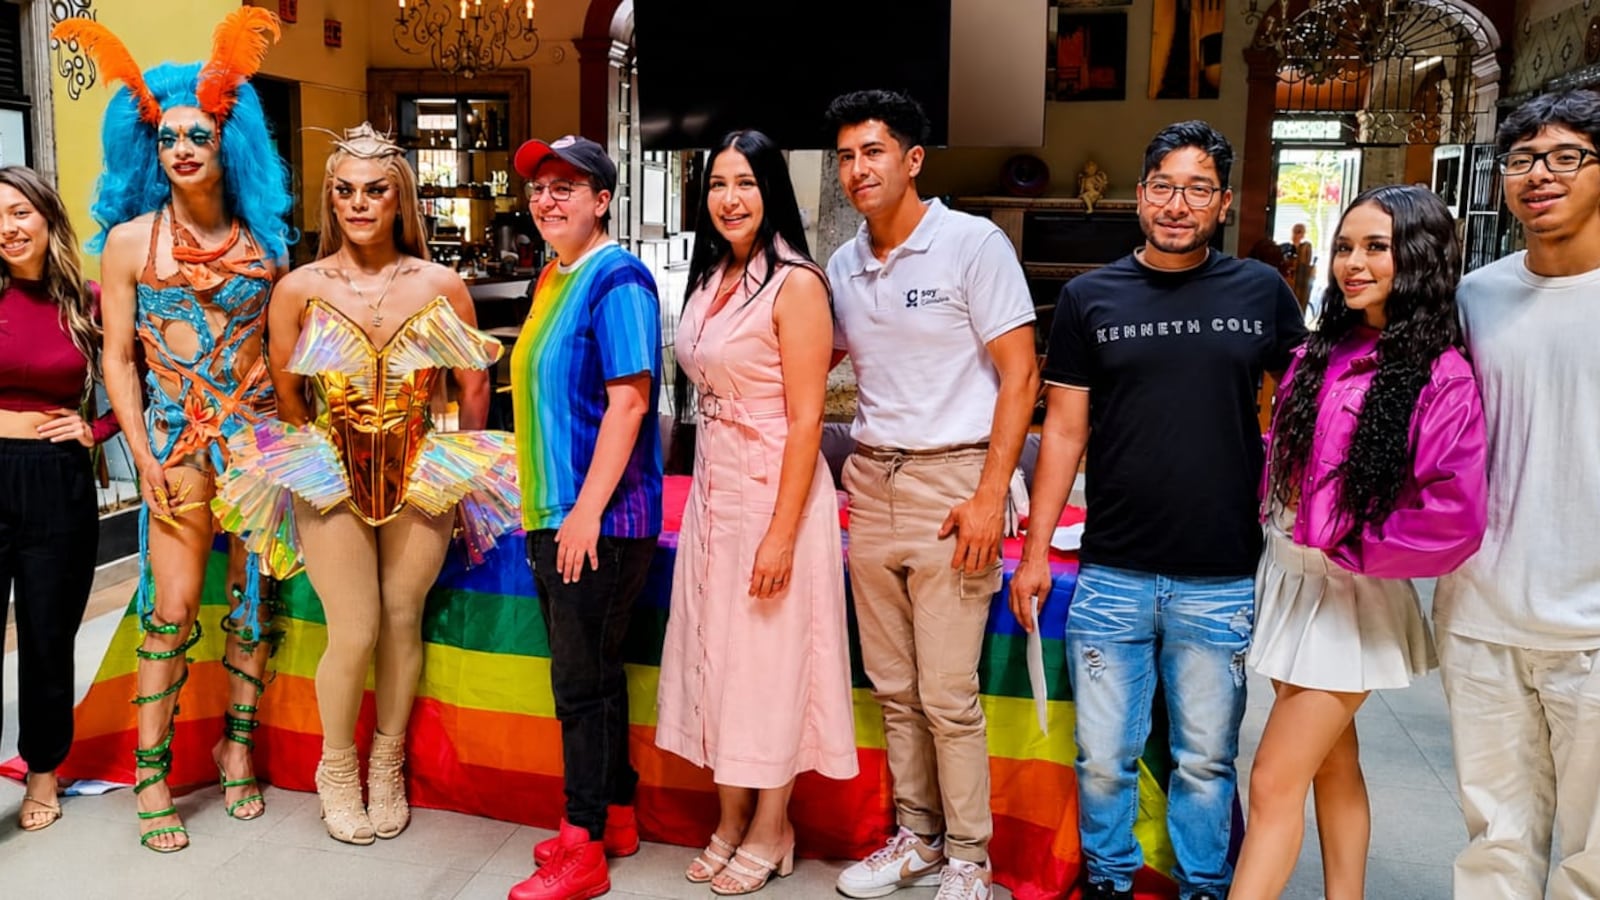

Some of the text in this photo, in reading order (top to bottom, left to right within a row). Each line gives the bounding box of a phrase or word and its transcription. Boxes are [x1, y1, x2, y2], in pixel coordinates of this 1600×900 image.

[921, 289, 937, 298] soy
[1096, 318, 1263, 343] KENNETH COLE
